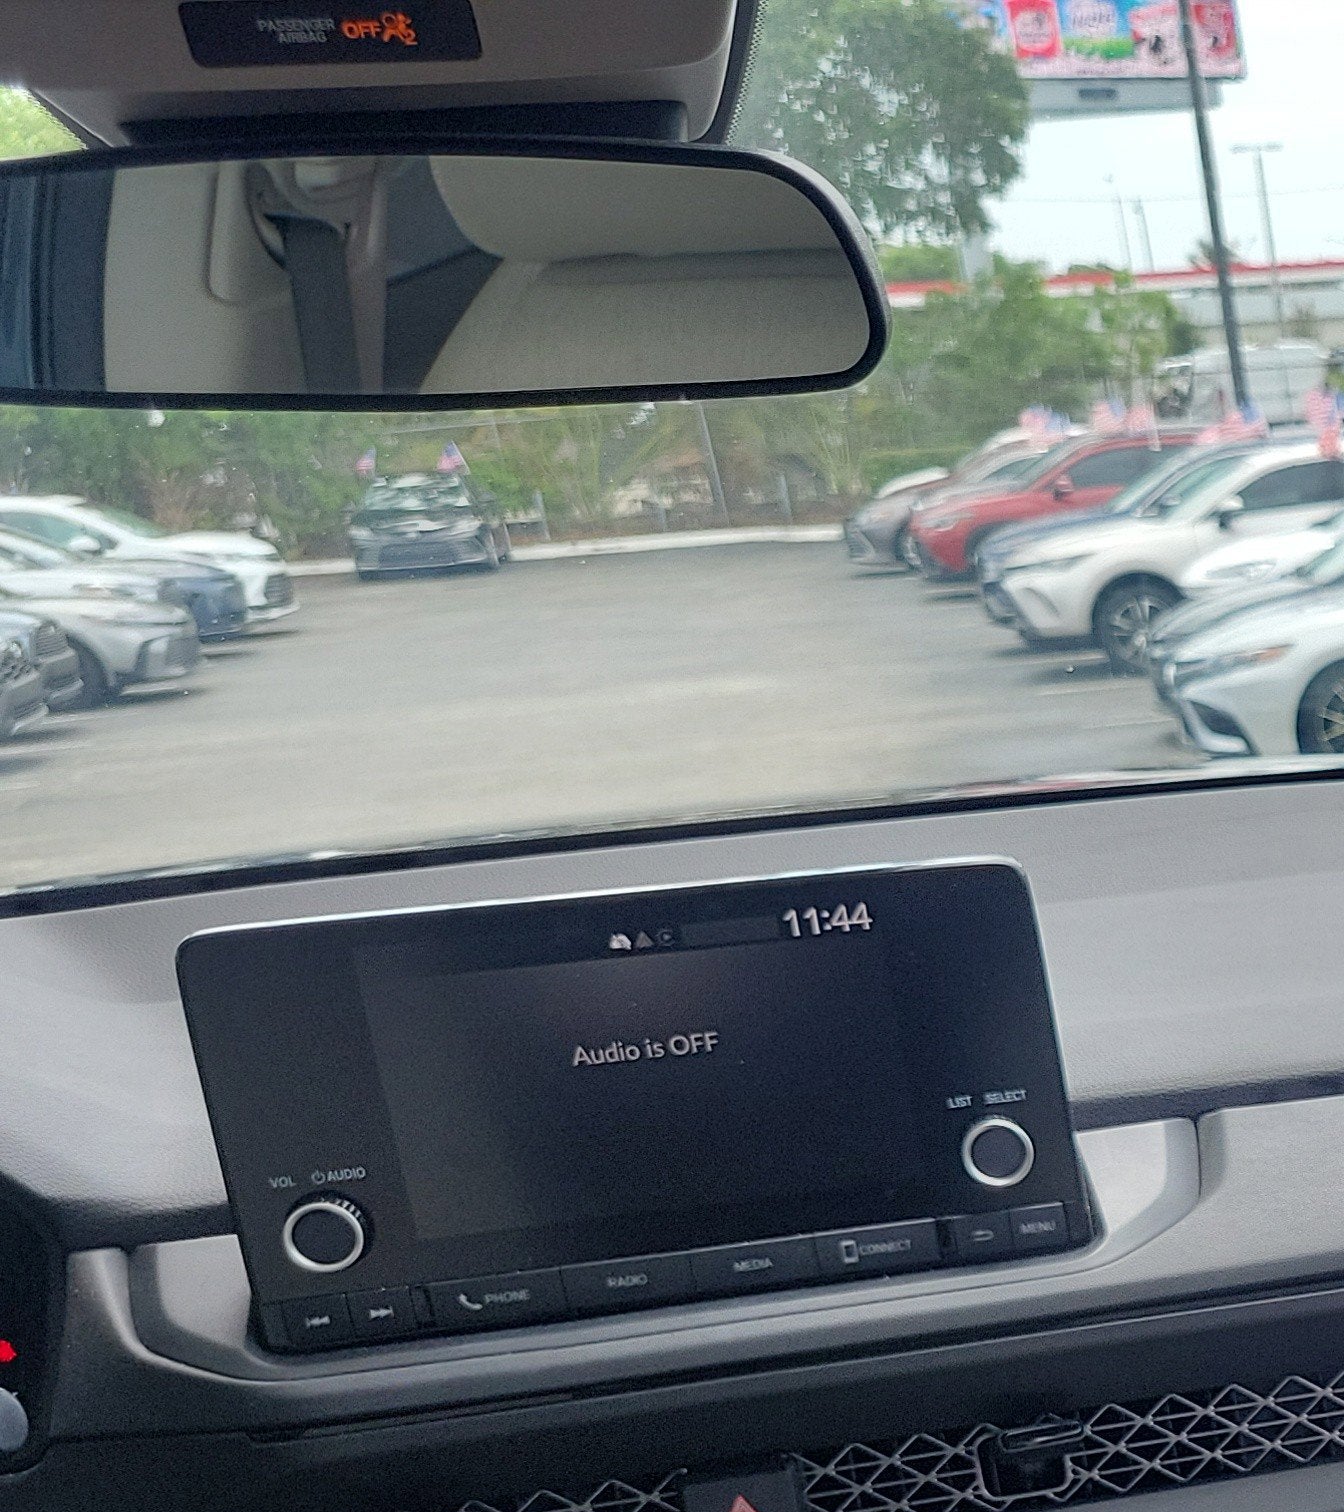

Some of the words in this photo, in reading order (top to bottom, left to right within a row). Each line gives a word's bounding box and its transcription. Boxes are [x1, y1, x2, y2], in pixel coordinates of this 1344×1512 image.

[256, 18, 336, 32] PASSENGER
[341, 20, 382, 39] OFF
[278, 31, 328, 44] AIRBAG
[782, 902, 873, 938] 11:44
[572, 1041, 641, 1067] Audio
[646, 1038, 664, 1059] is
[668, 1031, 719, 1056] OFF
[945, 1095, 972, 1109] LIST
[984, 1089, 1027, 1105] SELECT
[268, 1175, 297, 1188] VOL
[327, 1164, 367, 1182] AUDIO
[1019, 1221, 1056, 1235] MENU
[859, 1239, 912, 1257] CONNECT
[733, 1256, 774, 1272] MEDIA
[606, 1273, 648, 1288] RADIO
[485, 1288, 531, 1305] PHONE
